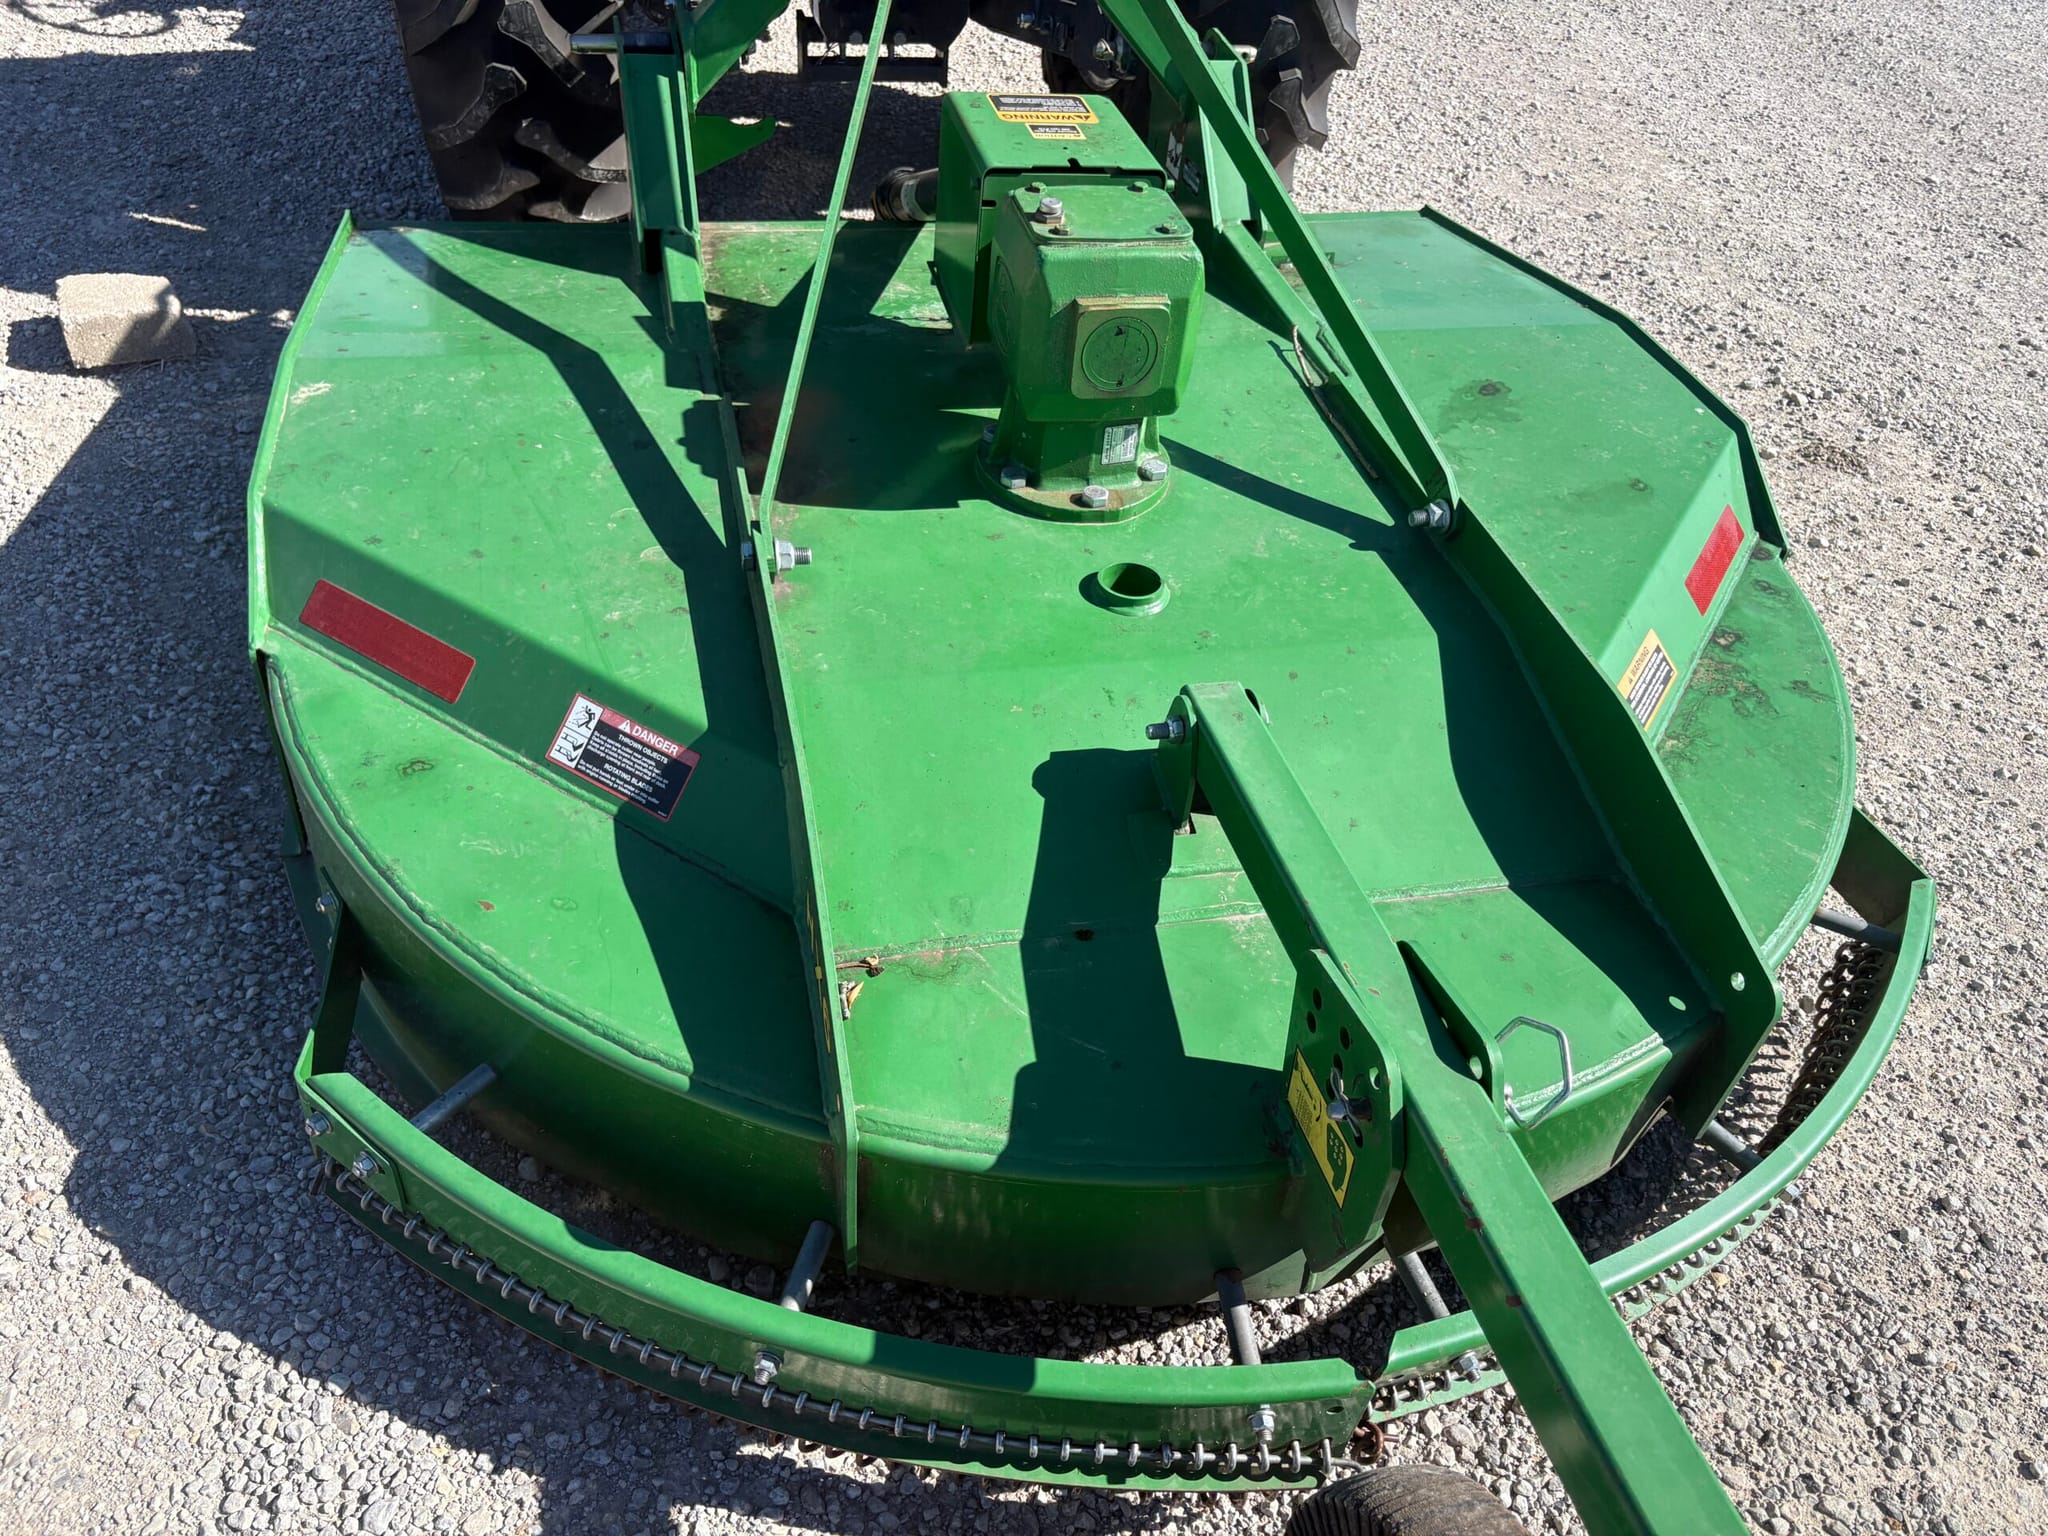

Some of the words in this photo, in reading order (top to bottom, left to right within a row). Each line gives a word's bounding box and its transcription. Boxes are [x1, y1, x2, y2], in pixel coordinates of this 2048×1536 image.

[1001, 113, 1076, 121] WARNING
[1630, 646, 1650, 677] WARNING
[617, 734, 643, 751] THROWN
[642, 746, 668, 764] OBJECTS
[631, 725, 679, 755] DANGER
[603, 763, 631, 781] ROTATING
[630, 777, 653, 792] BLADES
